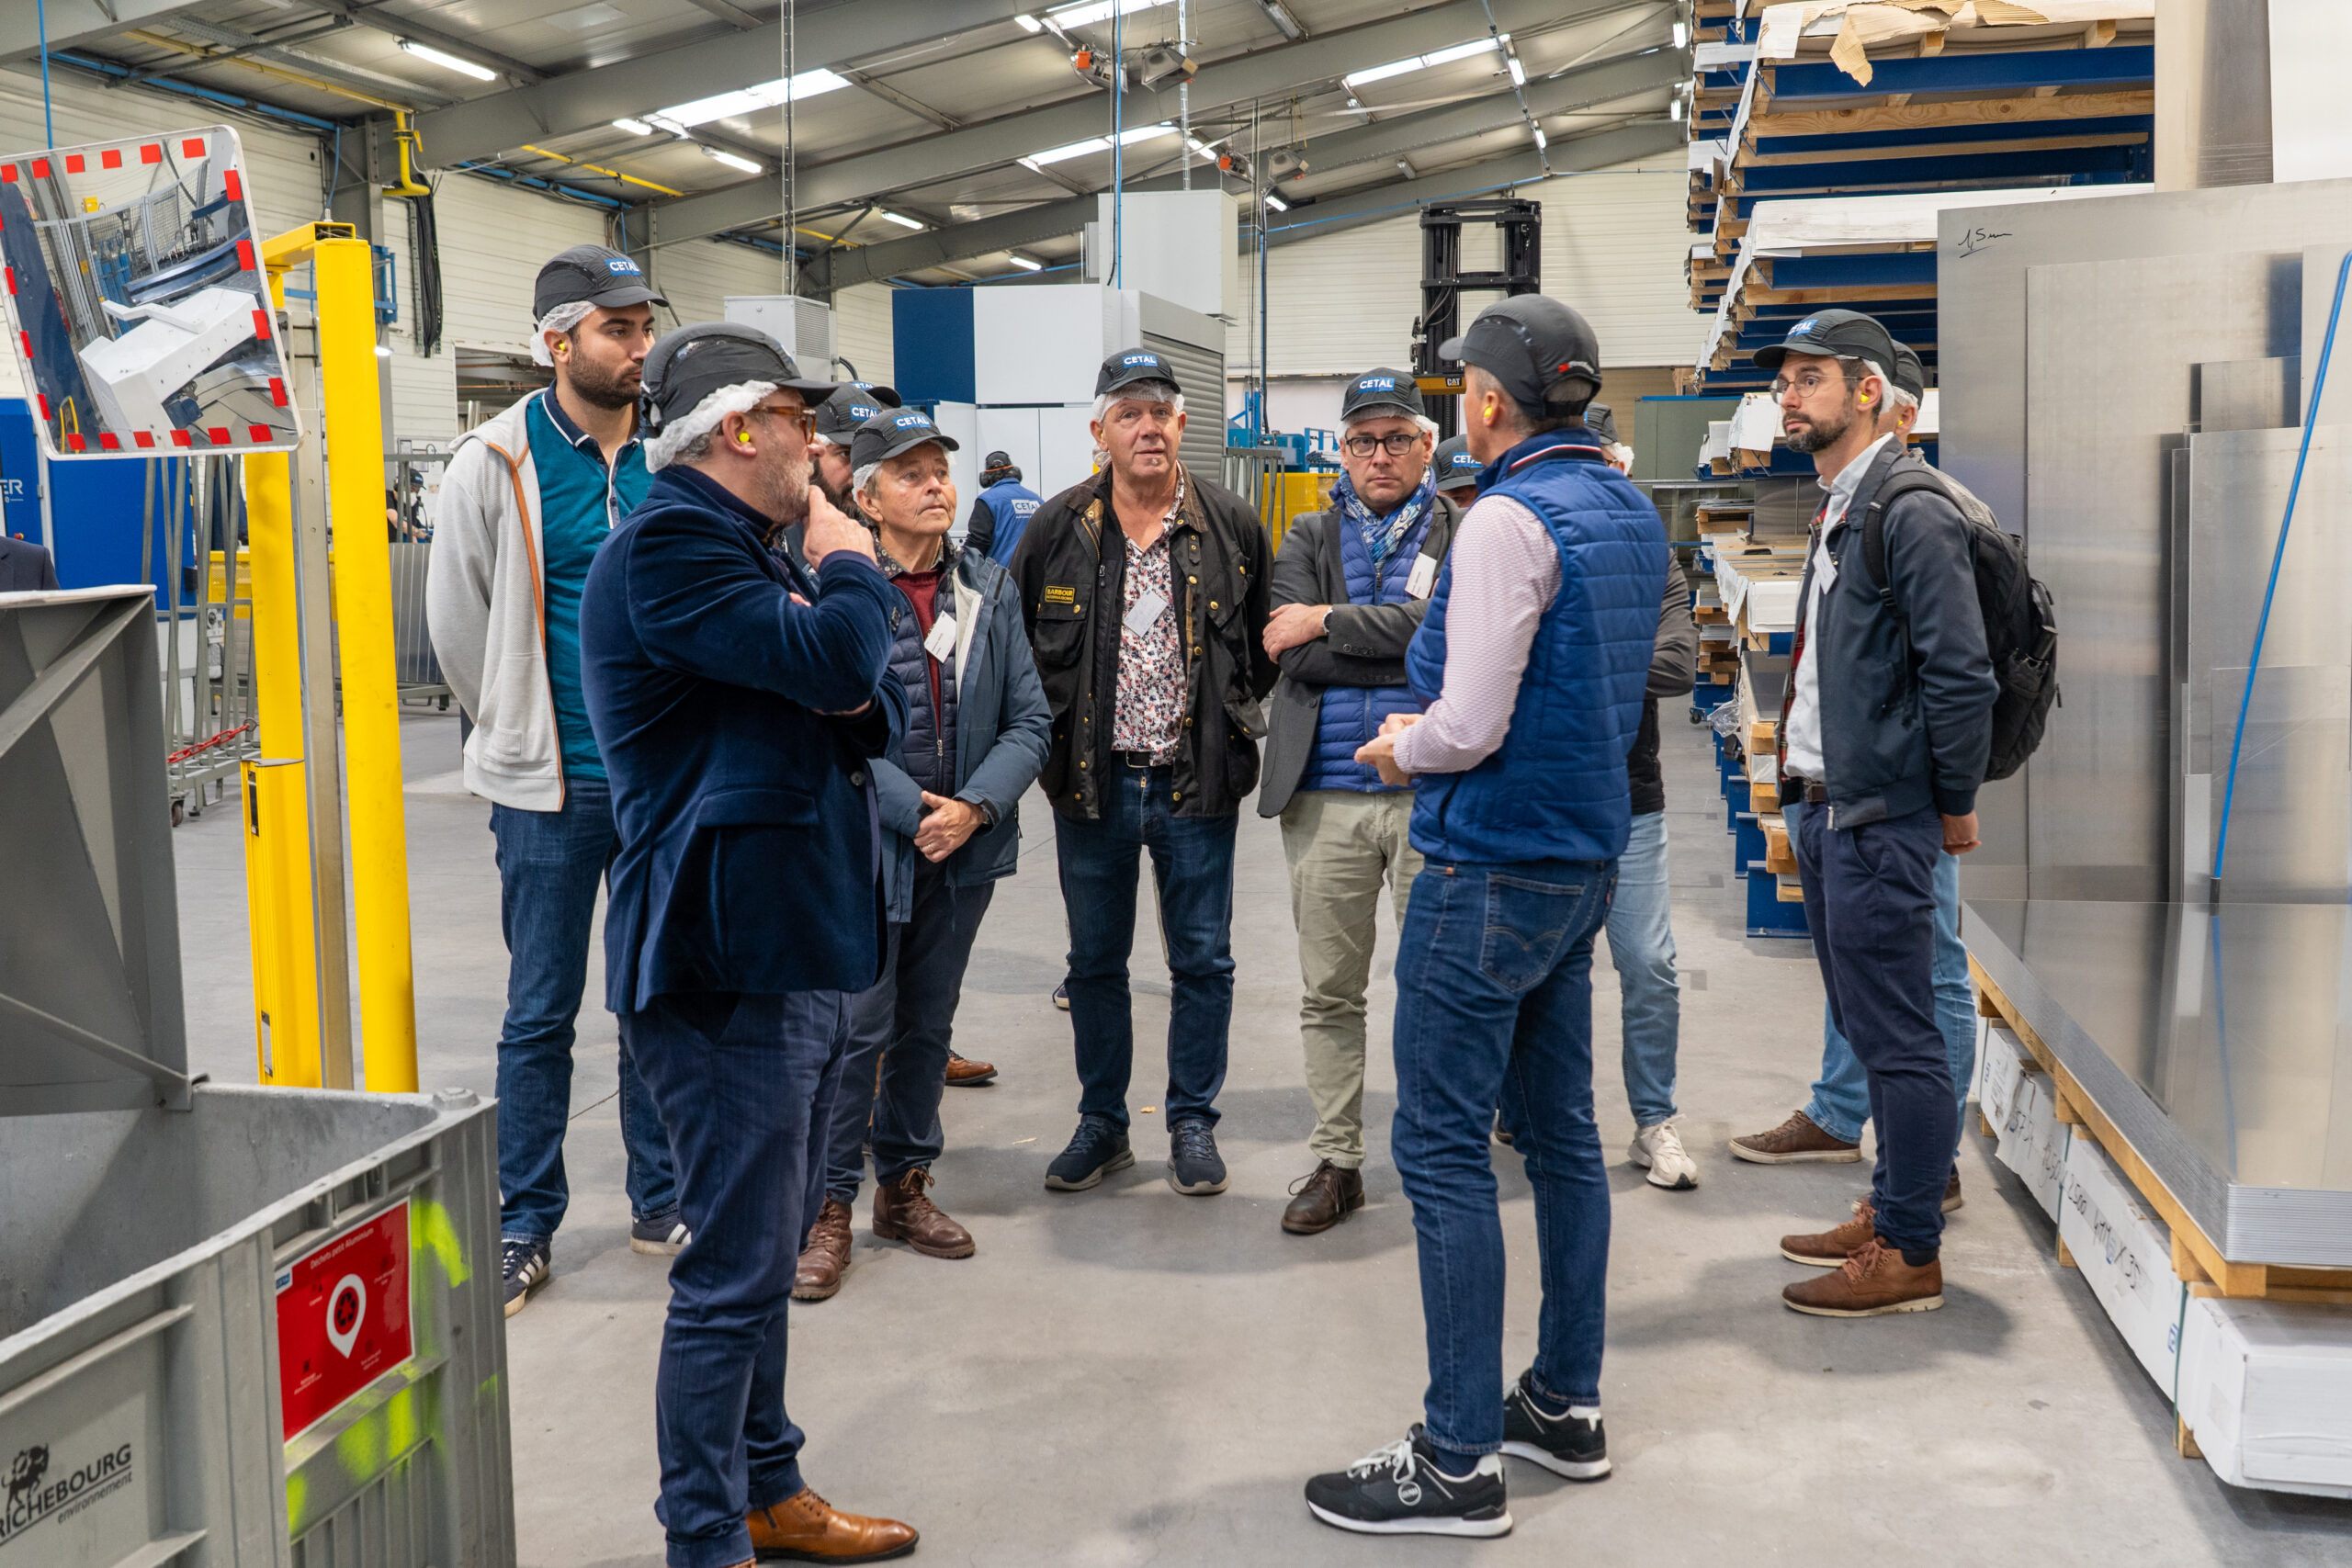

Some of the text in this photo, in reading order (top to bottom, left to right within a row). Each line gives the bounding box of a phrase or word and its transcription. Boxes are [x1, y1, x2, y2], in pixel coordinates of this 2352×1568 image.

[609, 261, 640, 272] CETAL
[1124, 355, 1157, 365] CETAL
[1359, 378, 1393, 389] CETAL
[1446, 378, 1461, 386] CAT
[896, 416, 930, 427] CETAL
[1046, 588, 1074, 596] BARBOUR
[57, 1472, 132, 1525] environnement
